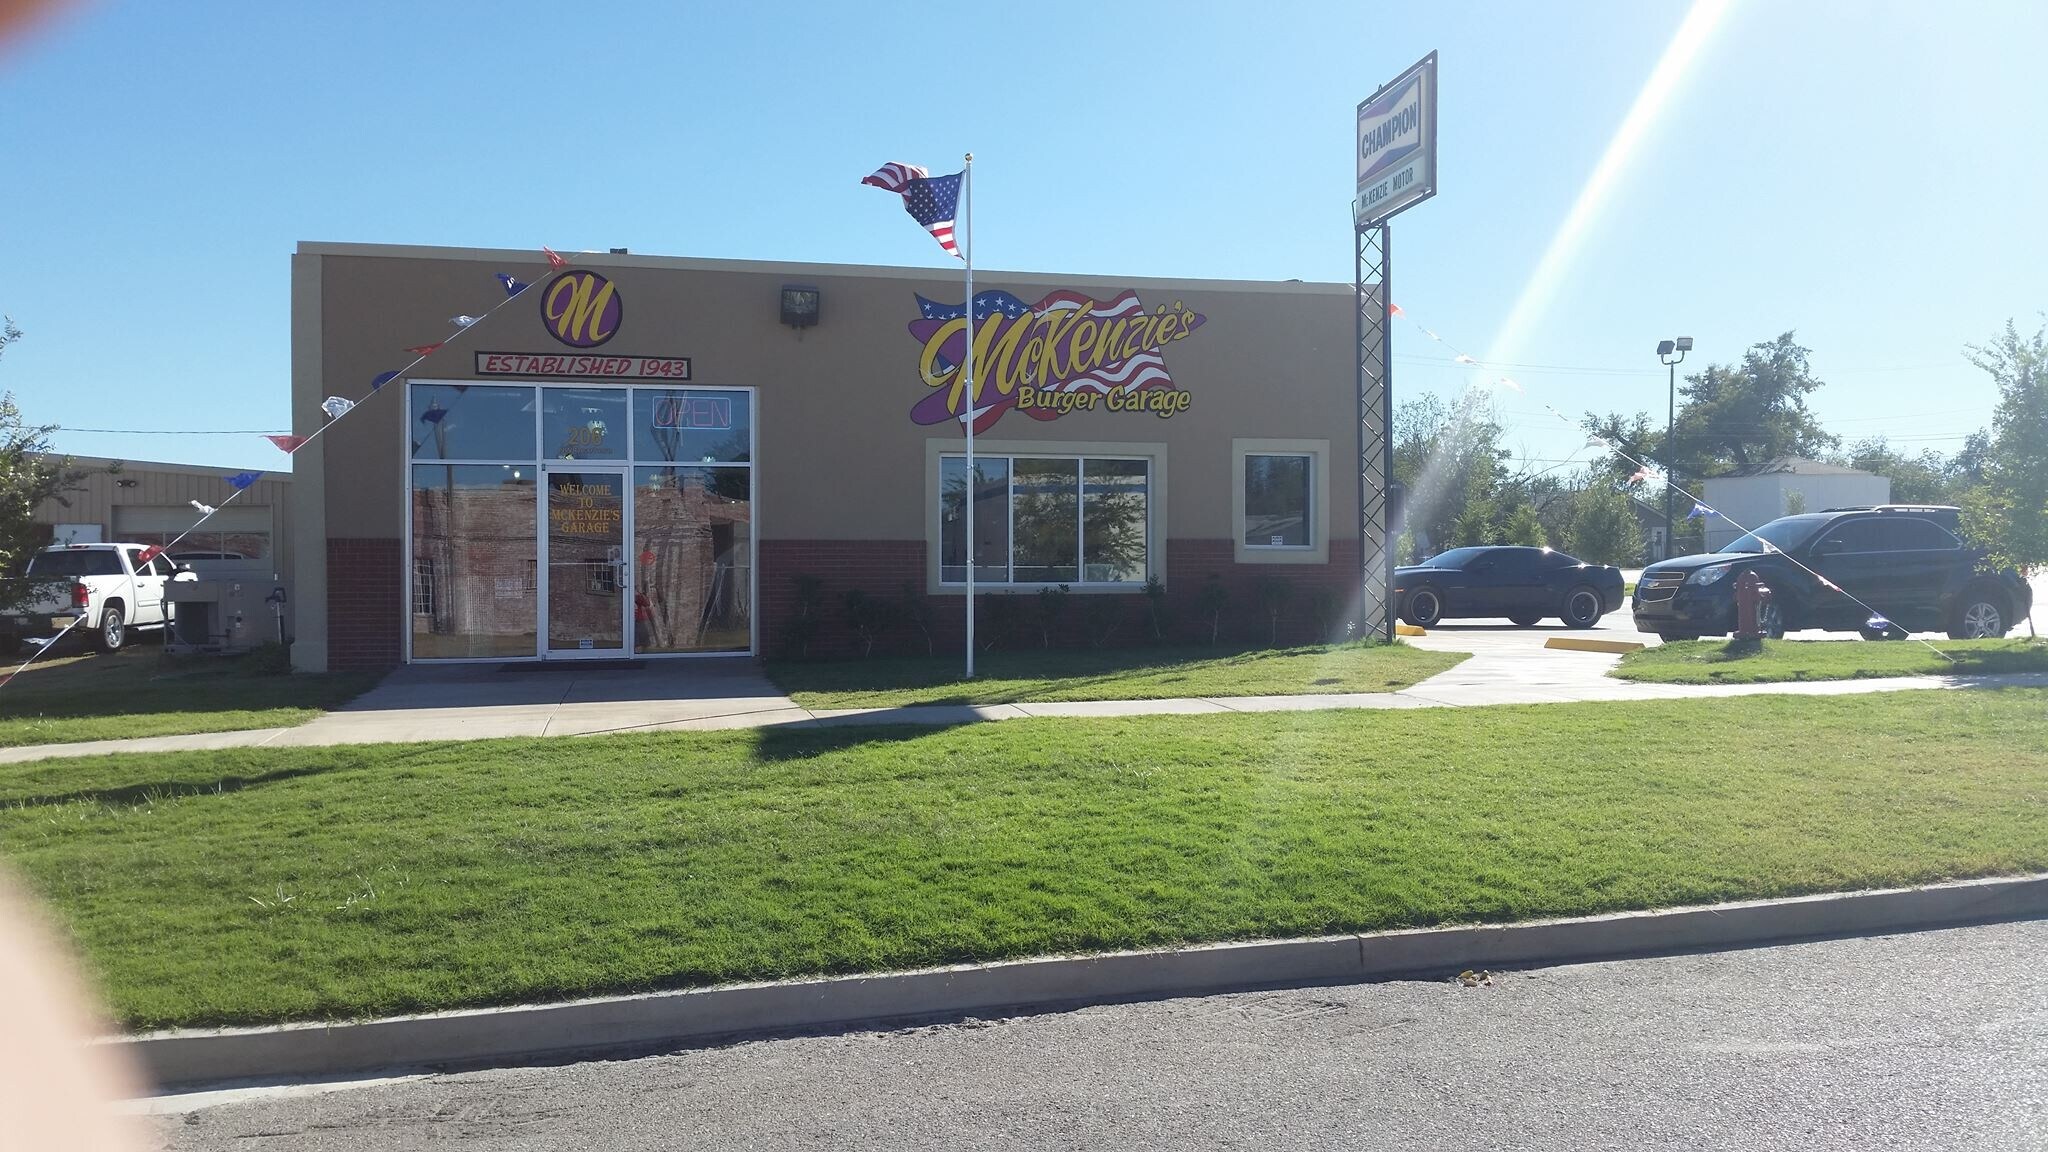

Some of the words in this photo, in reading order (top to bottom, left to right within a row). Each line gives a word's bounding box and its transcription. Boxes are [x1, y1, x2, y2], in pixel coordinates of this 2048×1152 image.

[1361, 101, 1417, 160] CHAMPION
[1392, 167, 1414, 192] MOTOR
[546, 273, 615, 342] M
[485, 355, 632, 376] ESTABLISHED
[639, 359, 685, 377] 1943
[655, 399, 729, 427] OPEN
[1017, 386, 1103, 415] Burger
[1105, 384, 1192, 419] Garage
[560, 484, 612, 496] WELCOME
[579, 497, 594, 508] TO
[561, 522, 609, 534] GARAGE
